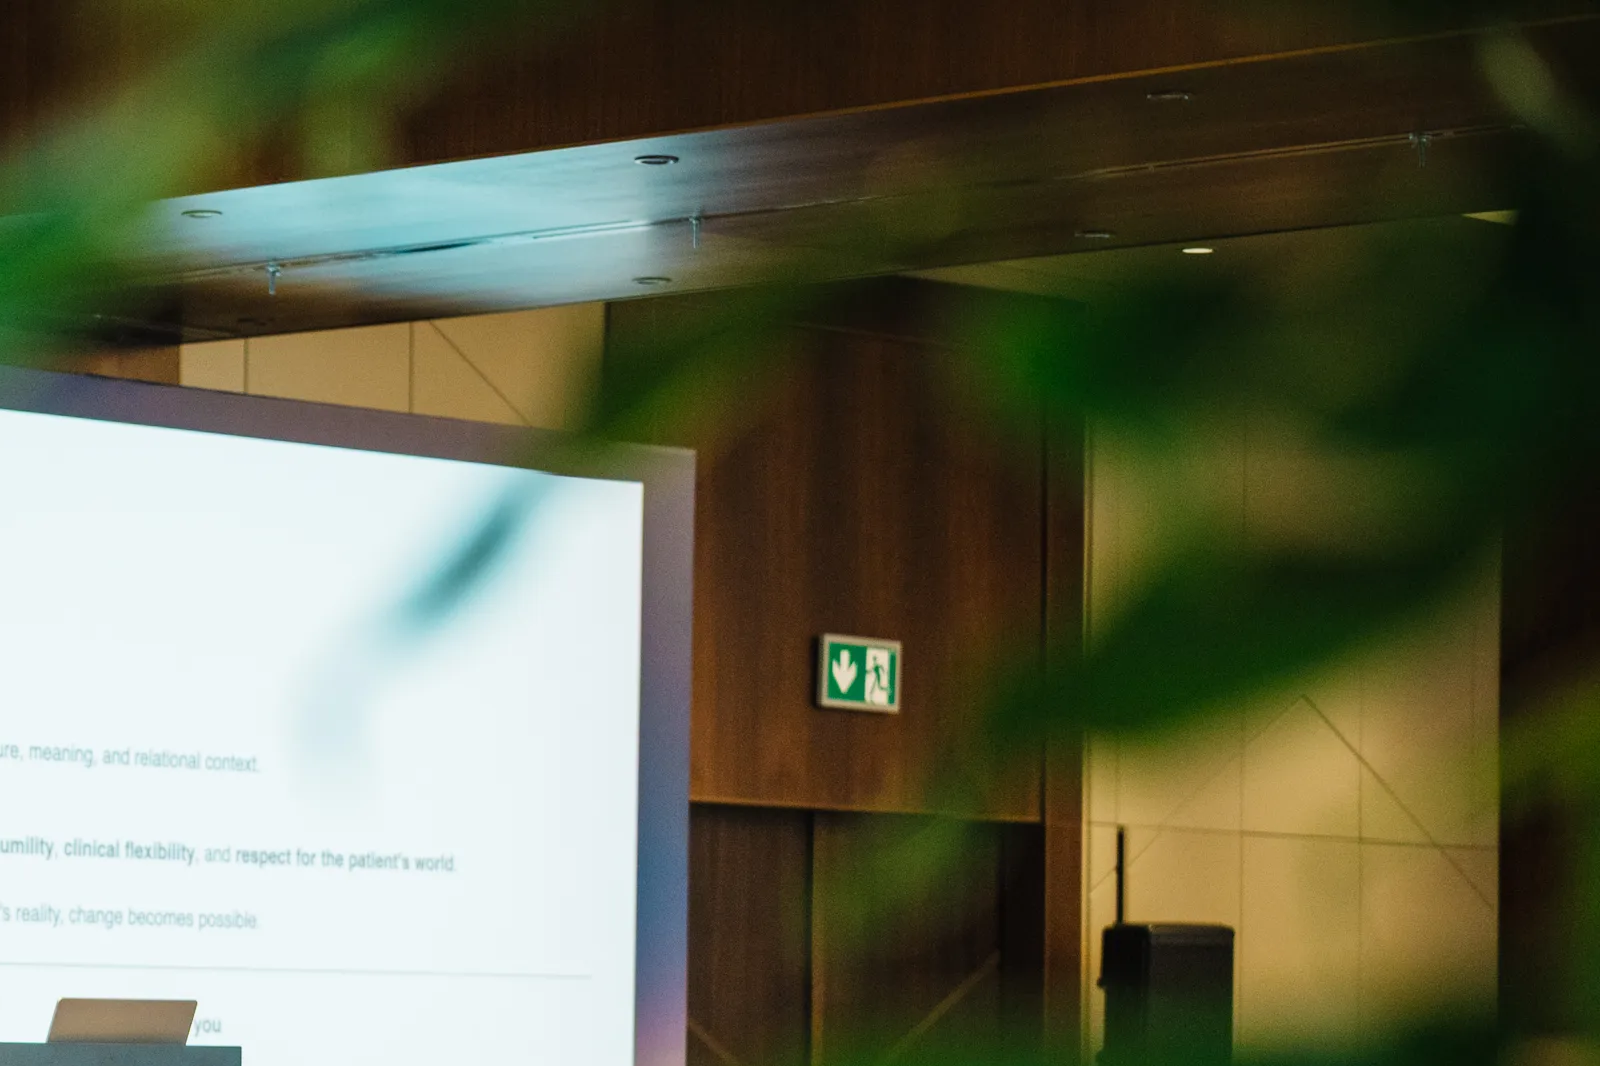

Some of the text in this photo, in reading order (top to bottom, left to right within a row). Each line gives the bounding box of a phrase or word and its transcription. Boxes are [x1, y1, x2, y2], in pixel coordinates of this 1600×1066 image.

[29, 743, 97, 769] meaning,
[102, 747, 130, 766] and
[134, 749, 200, 770] relational
[64, 839, 120, 859] clinical
[204, 846, 231, 864] and
[236, 848, 291, 868] respect
[296, 847, 317, 867] for
[321, 850, 344, 868] the
[349, 853, 410, 873] patient's
[16, 904, 64, 927] reality,
[69, 908, 123, 930] change
[128, 908, 194, 927] becomes
[194, 1019, 221, 1037] you
